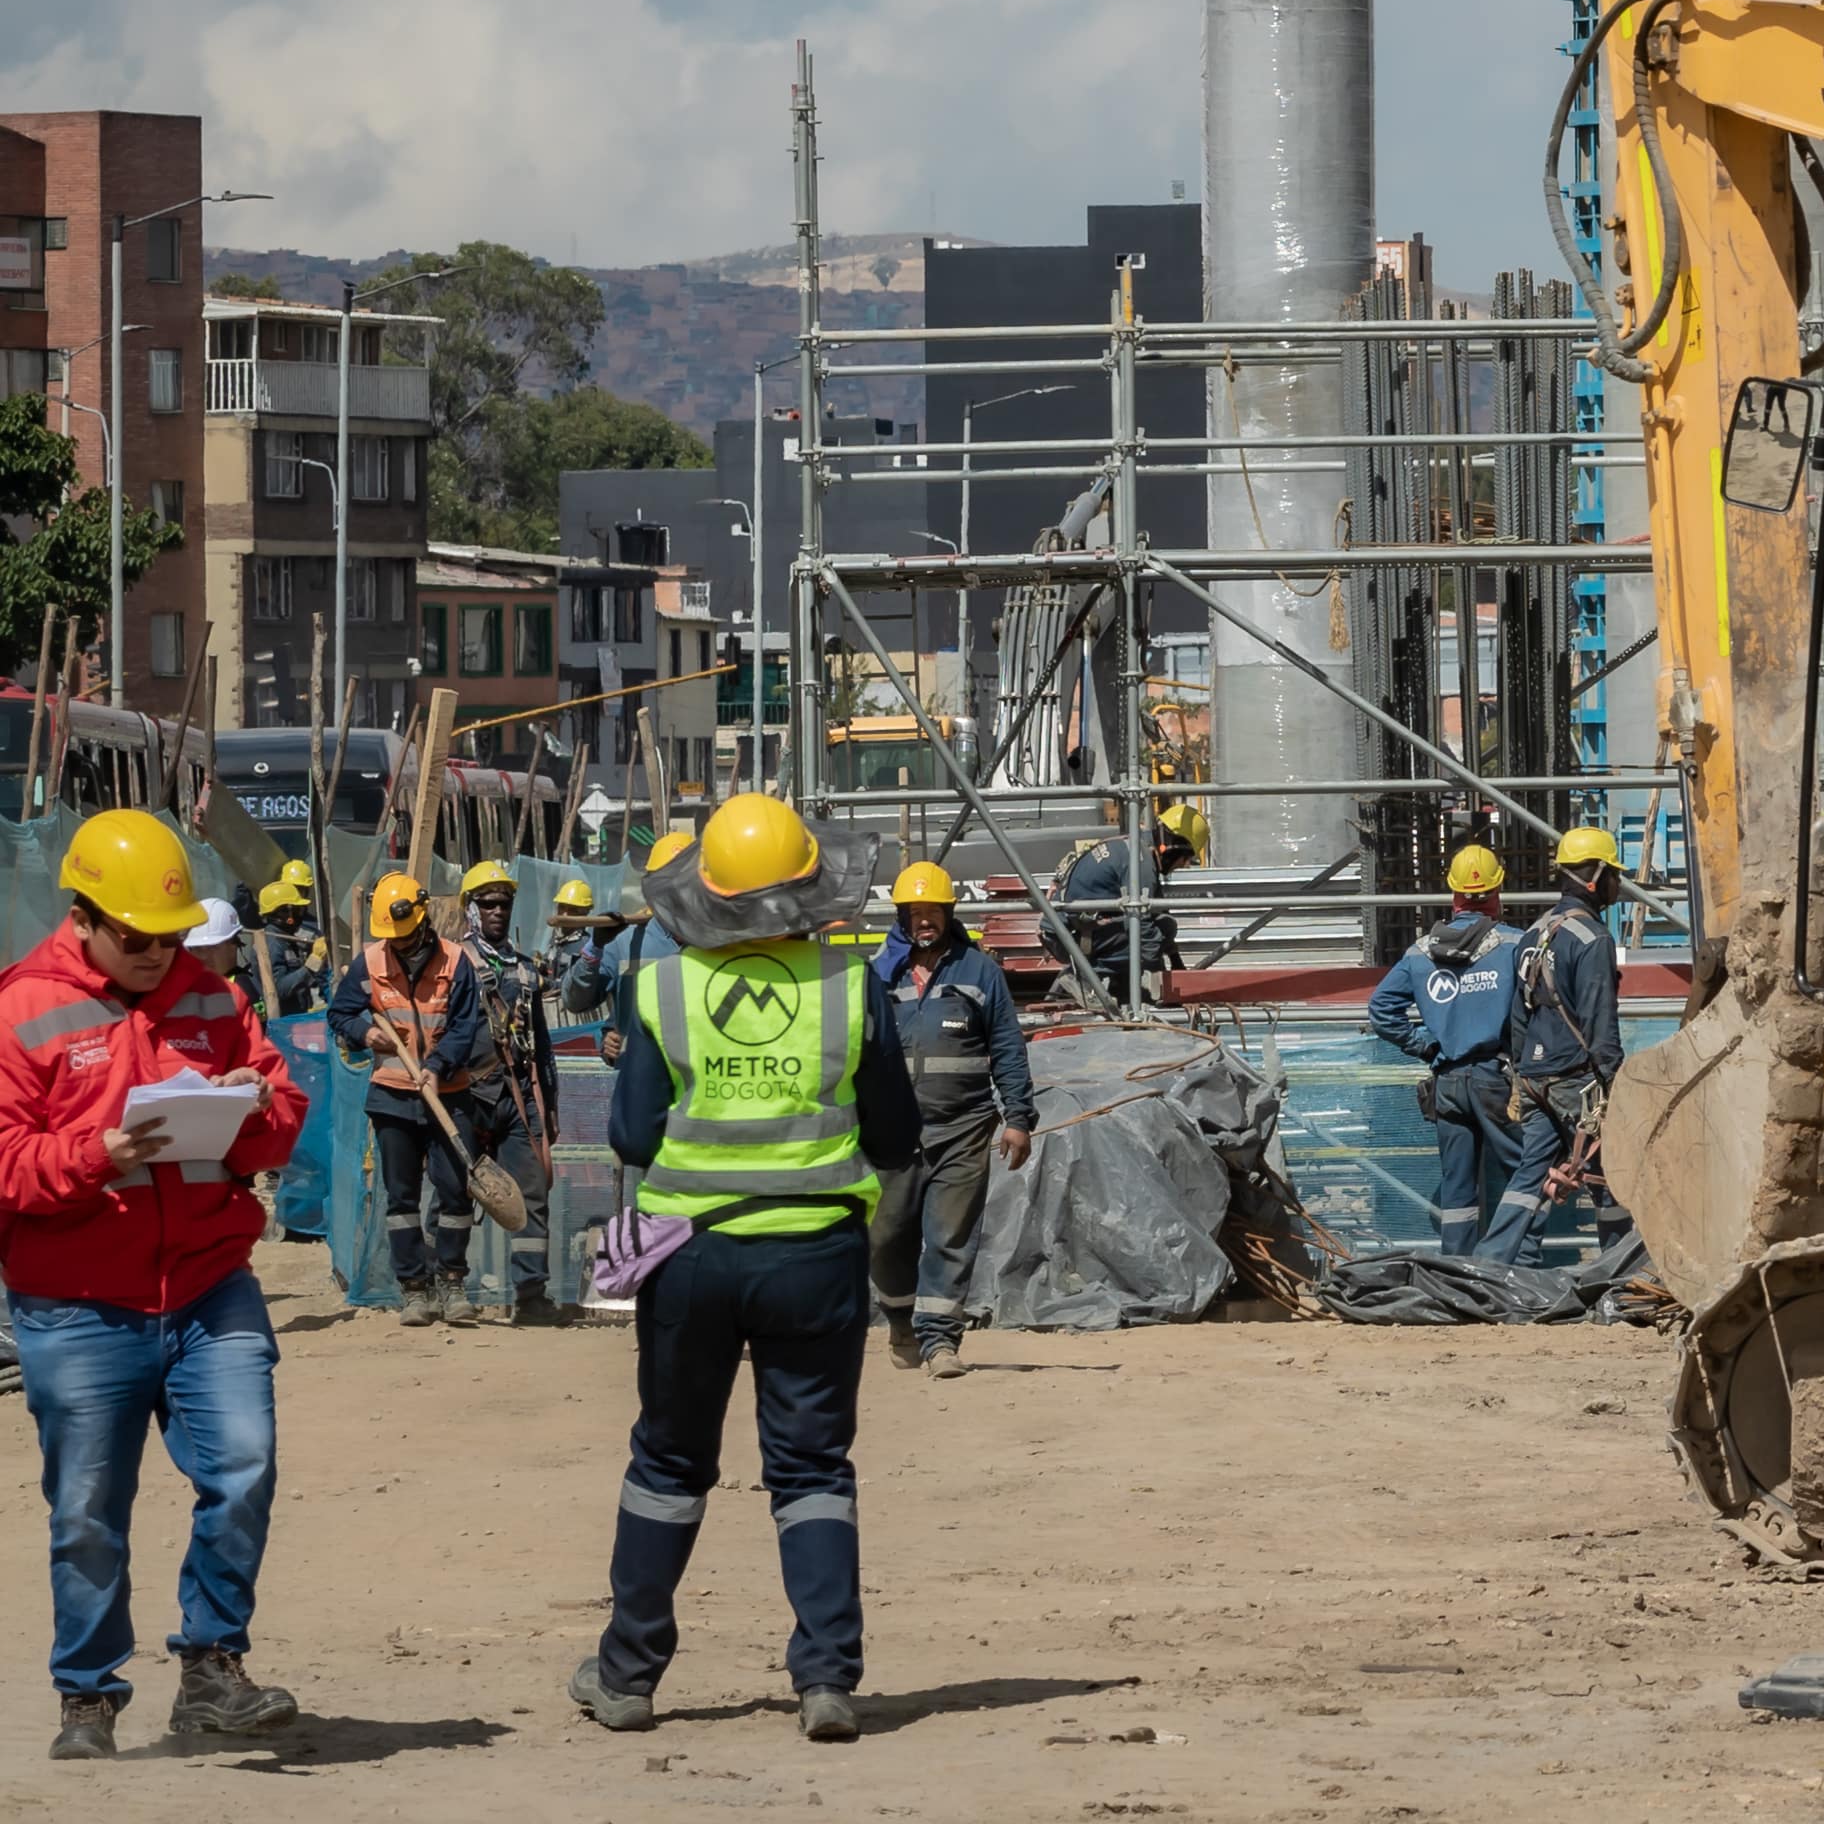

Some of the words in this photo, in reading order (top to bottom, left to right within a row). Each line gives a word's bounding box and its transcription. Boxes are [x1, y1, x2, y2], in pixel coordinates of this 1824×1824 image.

[1460, 970, 1499, 984] METRO
[705, 1056, 802, 1077] METRO
[704, 1077, 803, 1100] BOGOTÁ
